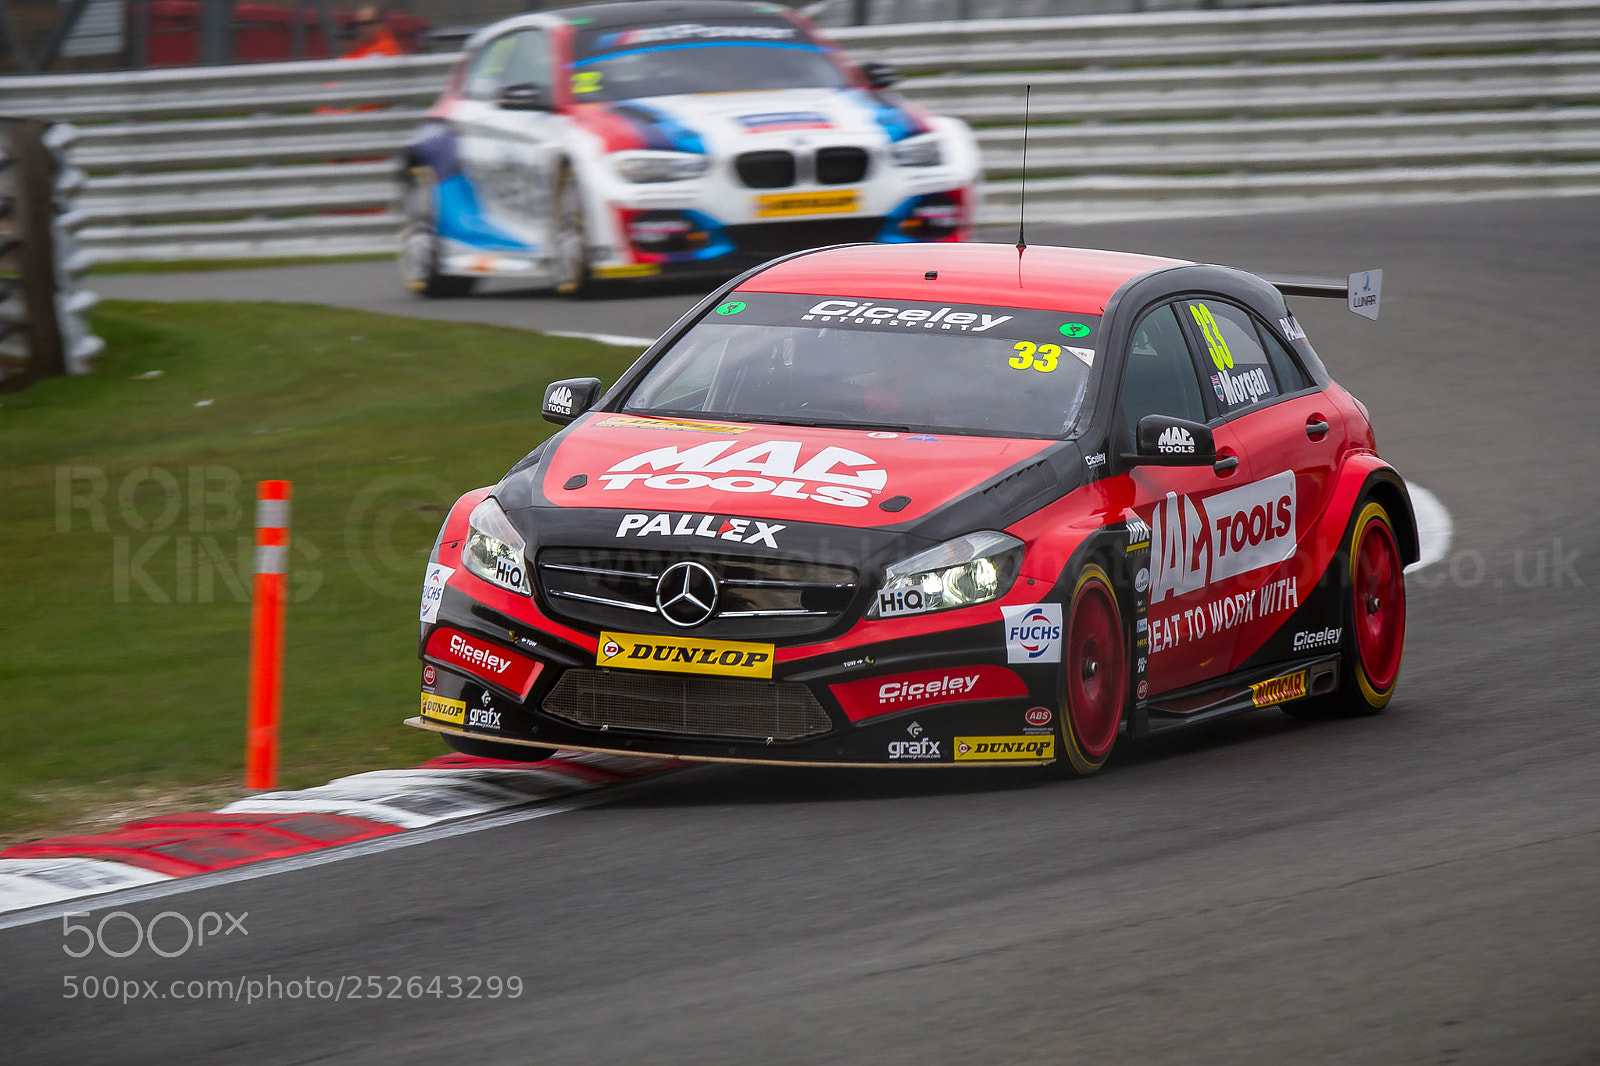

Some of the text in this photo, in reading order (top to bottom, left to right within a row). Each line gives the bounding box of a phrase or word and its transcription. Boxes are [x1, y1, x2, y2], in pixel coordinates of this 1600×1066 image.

[1353, 294, 1377, 308] LUNAR
[801, 314, 970, 332] MOTORSPORT
[808, 300, 1014, 332] Ciceley
[1190, 303, 1234, 371] 33
[1008, 341, 1062, 373] 33
[548, 386, 573, 408] MAC
[1217, 367, 1271, 406] Morgan
[547, 403, 571, 415] TOOLS
[1157, 426, 1195, 446] MAC
[1157, 445, 1195, 454] TOOLS
[606, 440, 888, 491] MAC
[598, 473, 873, 508] TOOLS
[615, 513, 787, 549] PALLEX
[1126, 520, 1150, 545] WIX
[1216, 495, 1293, 557] TOOLS
[495, 560, 522, 588] HiQ
[422, 585, 442, 601] UCHS
[879, 589, 924, 613] HiQ
[1184, 606, 1206, 642] TO
[1209, 592, 1256, 633] WORK
[1259, 576, 1298, 618] WITH
[1010, 626, 1061, 641] FUCHS
[1294, 627, 1343, 646] Ciceley
[449, 634, 511, 673] Ciceley
[627, 643, 769, 667] DUNLOP
[879, 674, 980, 698] Ciceley
[880, 688, 963, 704] MOTORSPORT
[1256, 673, 1303, 704] AUTOCAR
[427, 700, 463, 716] DUNLOP
[469, 707, 502, 726] grafx
[1029, 711, 1049, 720] ABS
[888, 737, 940, 759] grafx
[974, 742, 1051, 756] DUNLOP
